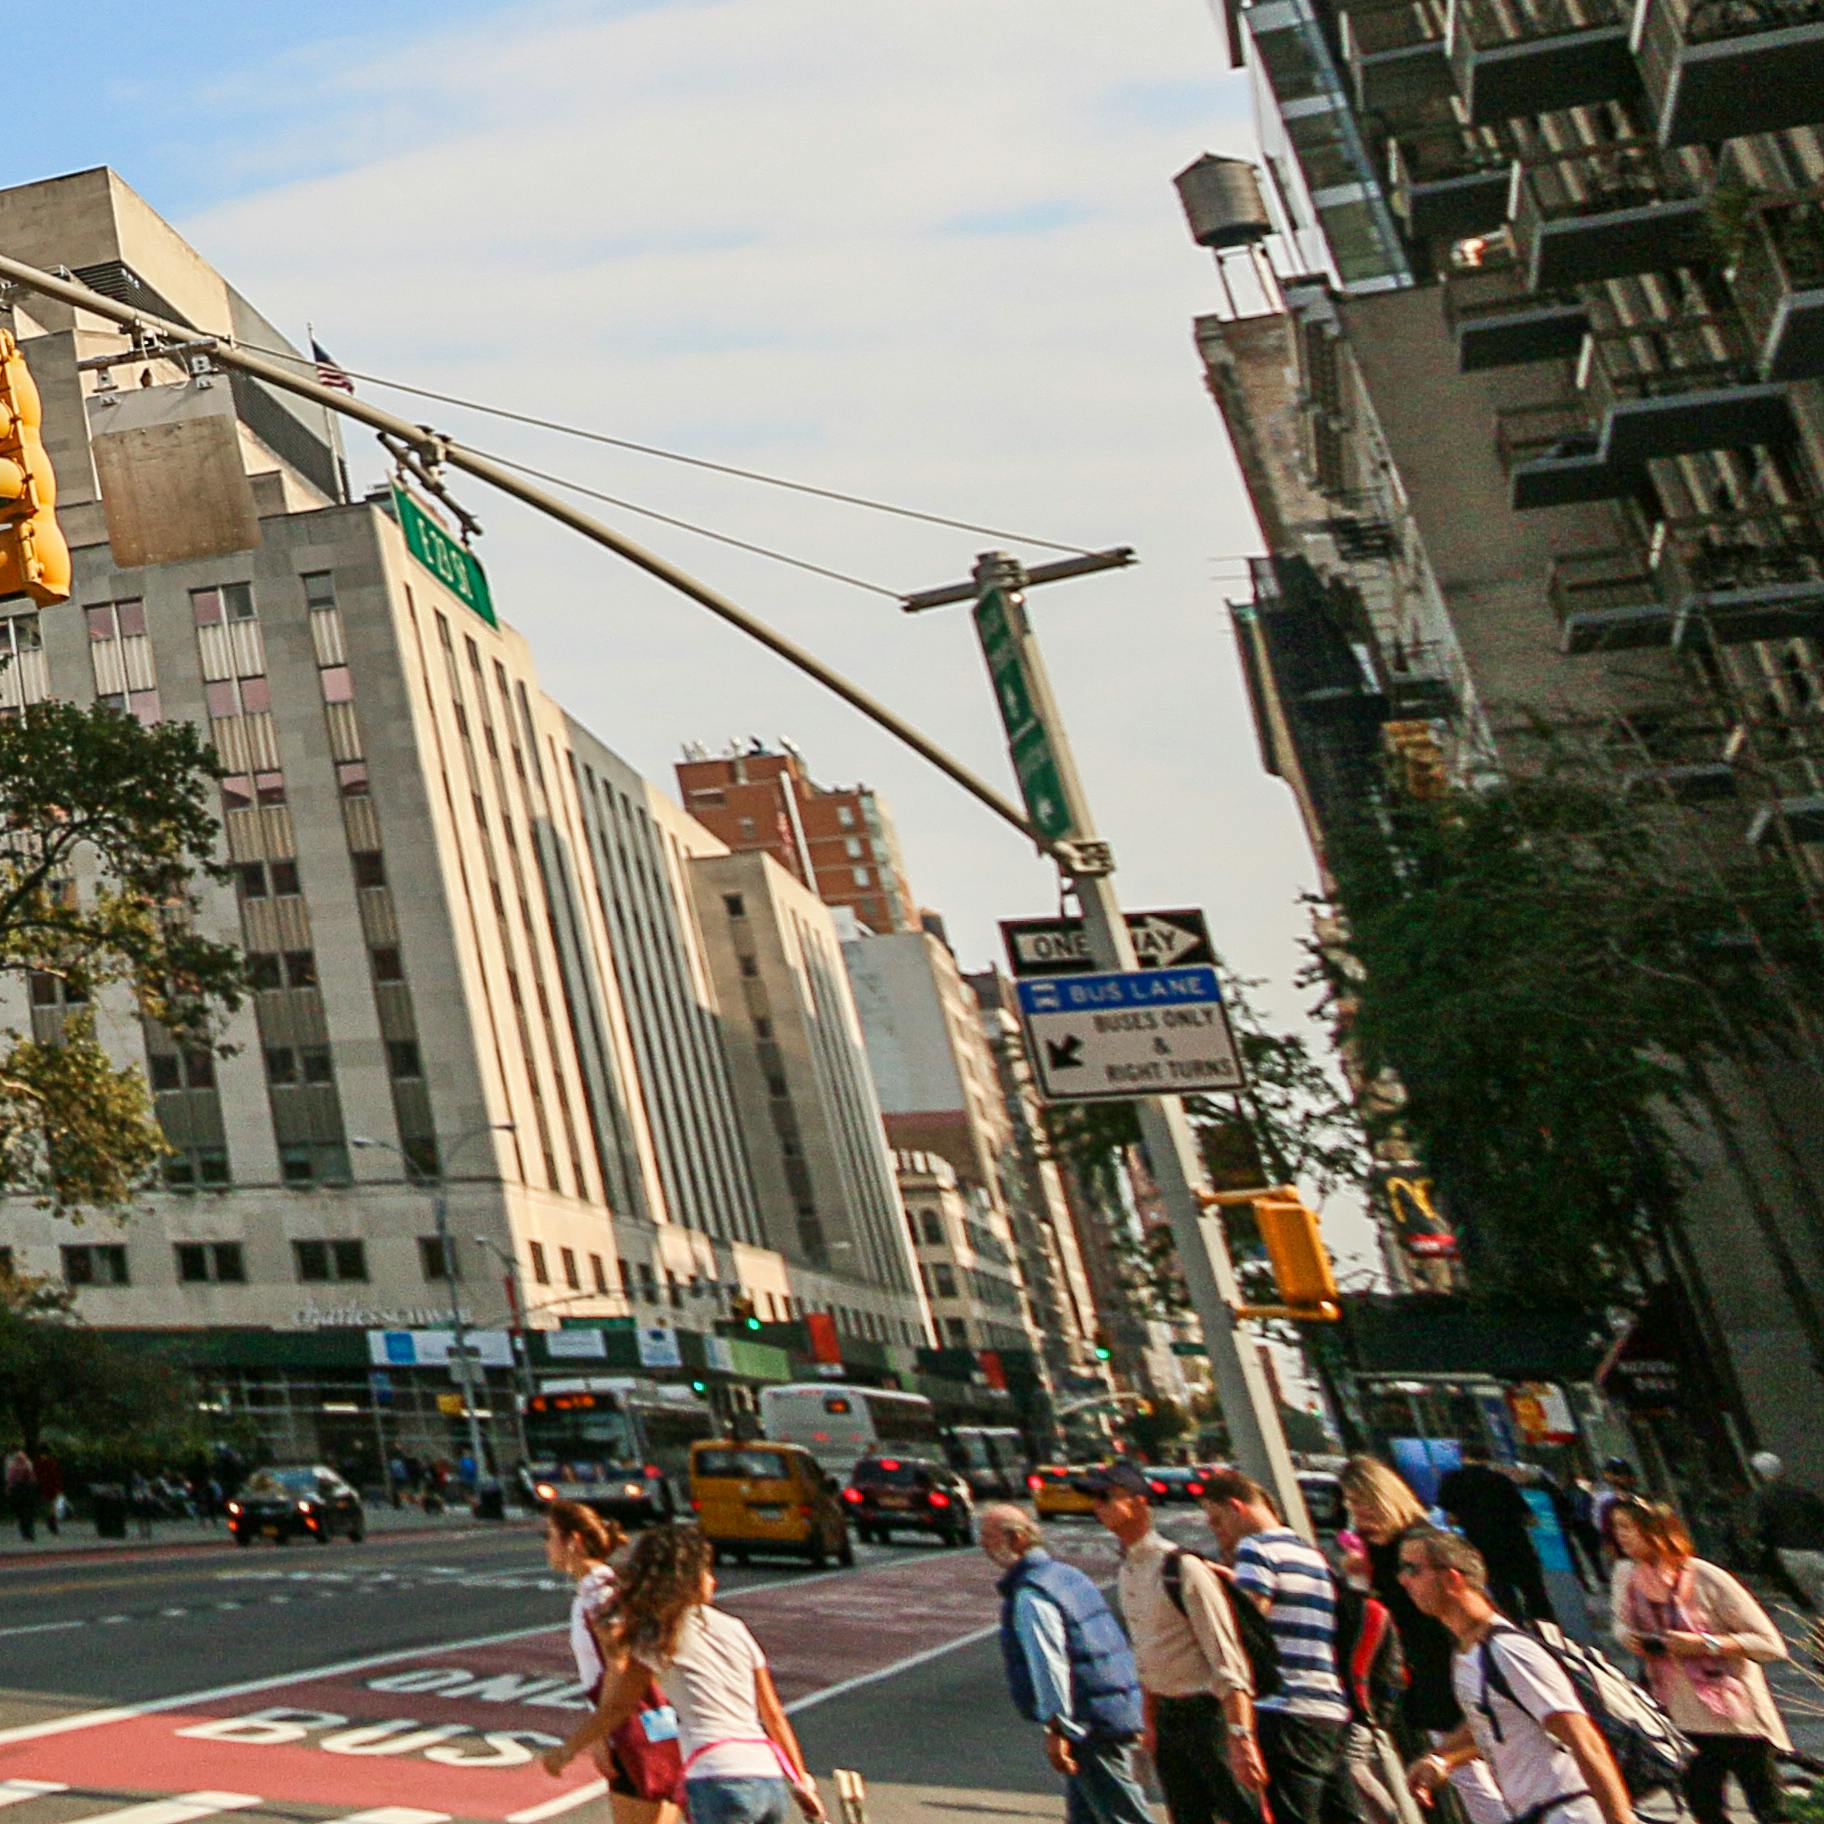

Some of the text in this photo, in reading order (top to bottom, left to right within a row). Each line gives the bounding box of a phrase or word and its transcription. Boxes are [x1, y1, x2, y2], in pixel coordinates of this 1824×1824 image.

[1033, 931, 1091, 960] ONE
[1068, 974, 1208, 1004] BUS LANE
[1093, 1006, 1214, 1033] BUSES ONLY
[1154, 1036, 1169, 1054] &
[1104, 1057, 1234, 1083] RIGHT TURNS
[365, 1667, 595, 1713] ONL
[174, 1706, 565, 1769] BUS
